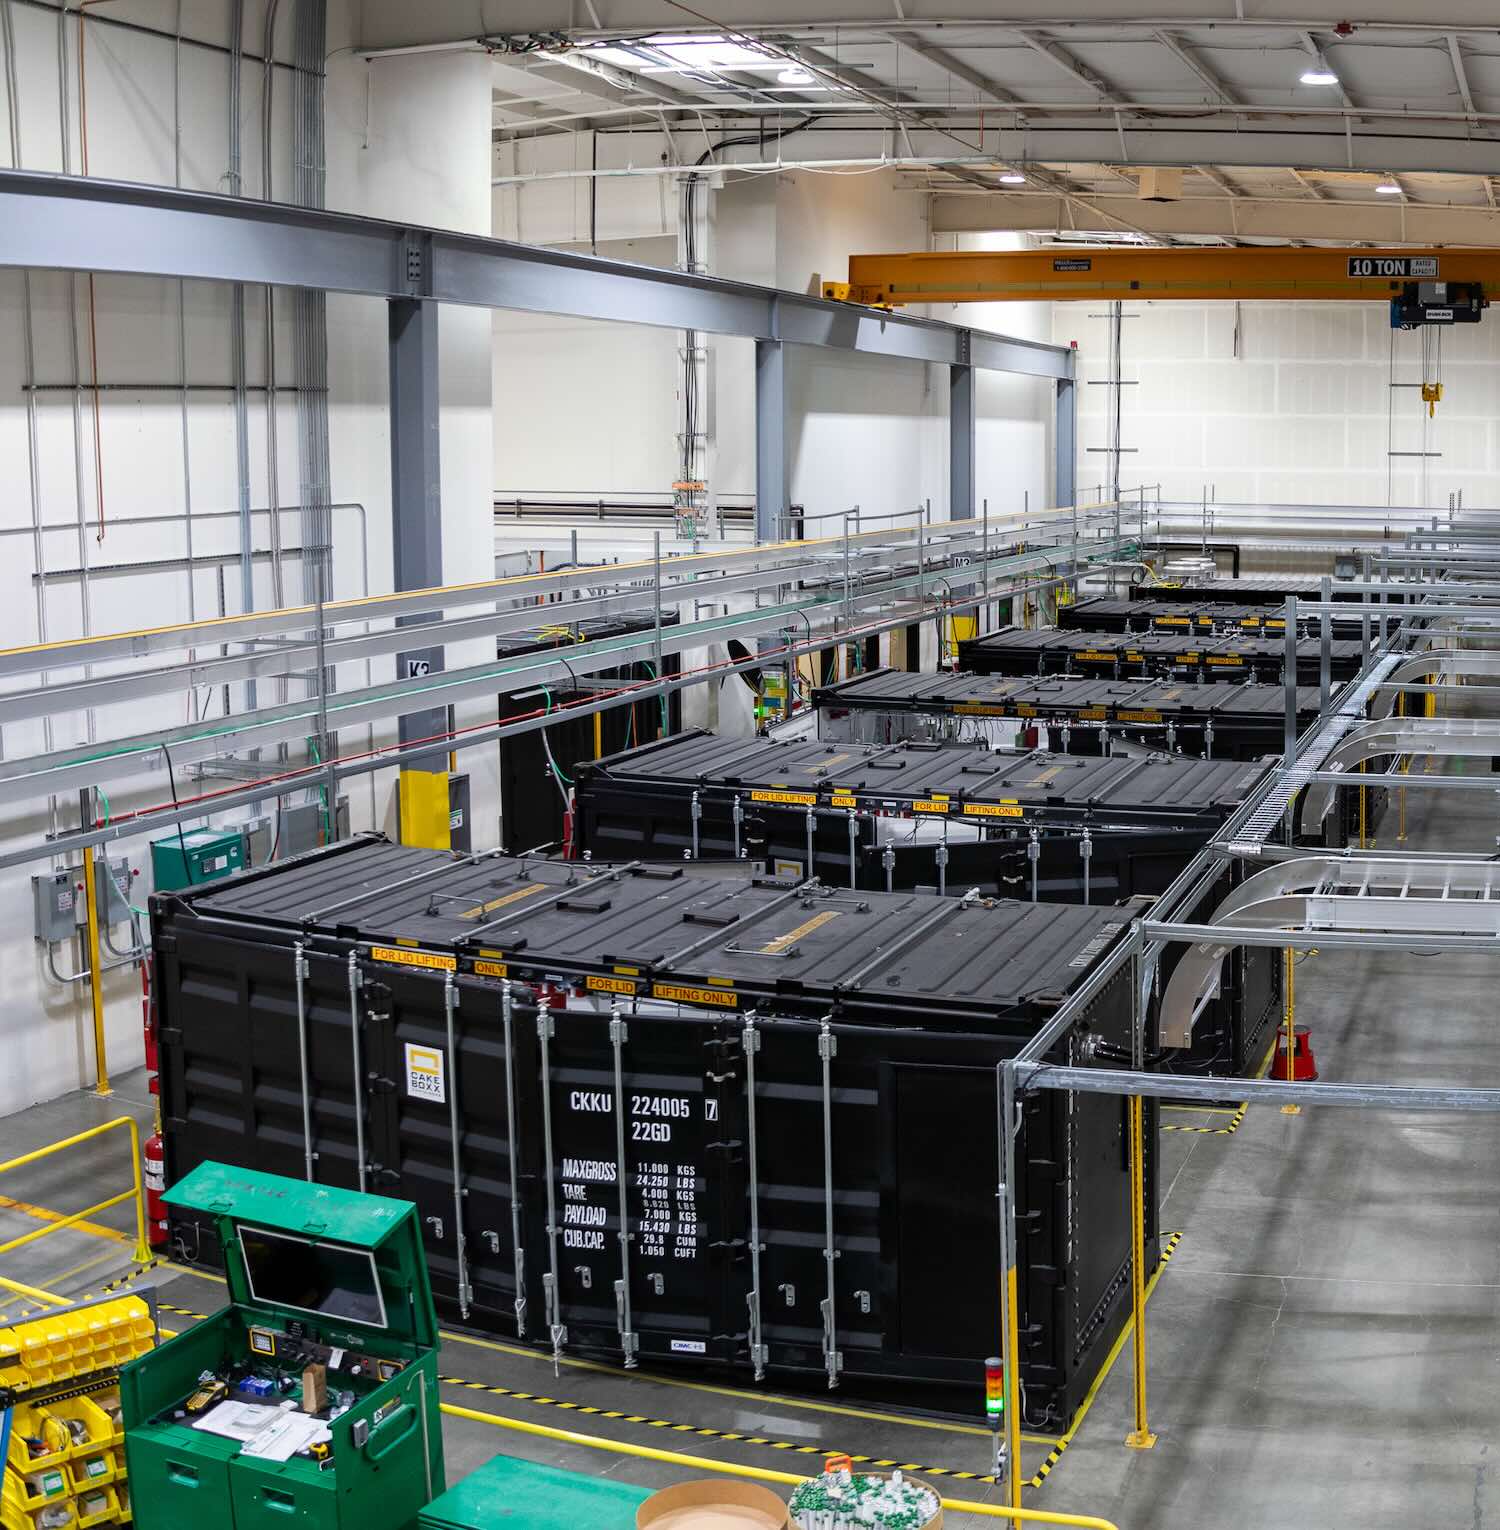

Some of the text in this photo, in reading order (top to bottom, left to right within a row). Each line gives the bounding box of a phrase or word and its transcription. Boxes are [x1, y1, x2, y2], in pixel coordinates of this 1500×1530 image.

[1353, 260, 1405, 275] 10 TON
[753, 792, 769, 800] FOR
[833, 797, 854, 805] ONLY
[965, 806, 997, 814] LIFTING
[374, 950, 455, 970] FOR LID LIFTING
[476, 961, 505, 975] ONLY
[588, 978, 634, 993] FOR LID
[655, 985, 737, 1005] LIFTING ONLY
[411, 1071, 441, 1085] CAKE
[411, 1080, 441, 1093] BOXX
[571, 1091, 612, 1112] CKKU
[631, 1096, 690, 1118] 224005
[632, 1122, 671, 1142] 22GD
[562, 1158, 617, 1181] MAXGROSS
[677, 1165, 696, 1176] KGS
[636, 1175, 695, 1190] 24.250 LBS
[562, 1184, 588, 1201] TARE
[676, 1190, 695, 1201] KGS
[677, 1202, 696, 1211] LBS
[564, 1204, 607, 1226] PAYLOAD
[678, 1211, 697, 1222] KGS
[639, 1221, 697, 1235] 15.430 LBS
[564, 1229, 697, 1250] CUB.CAP. 29.8 CUM
[639, 1245, 697, 1258] 1.050 CUFT
